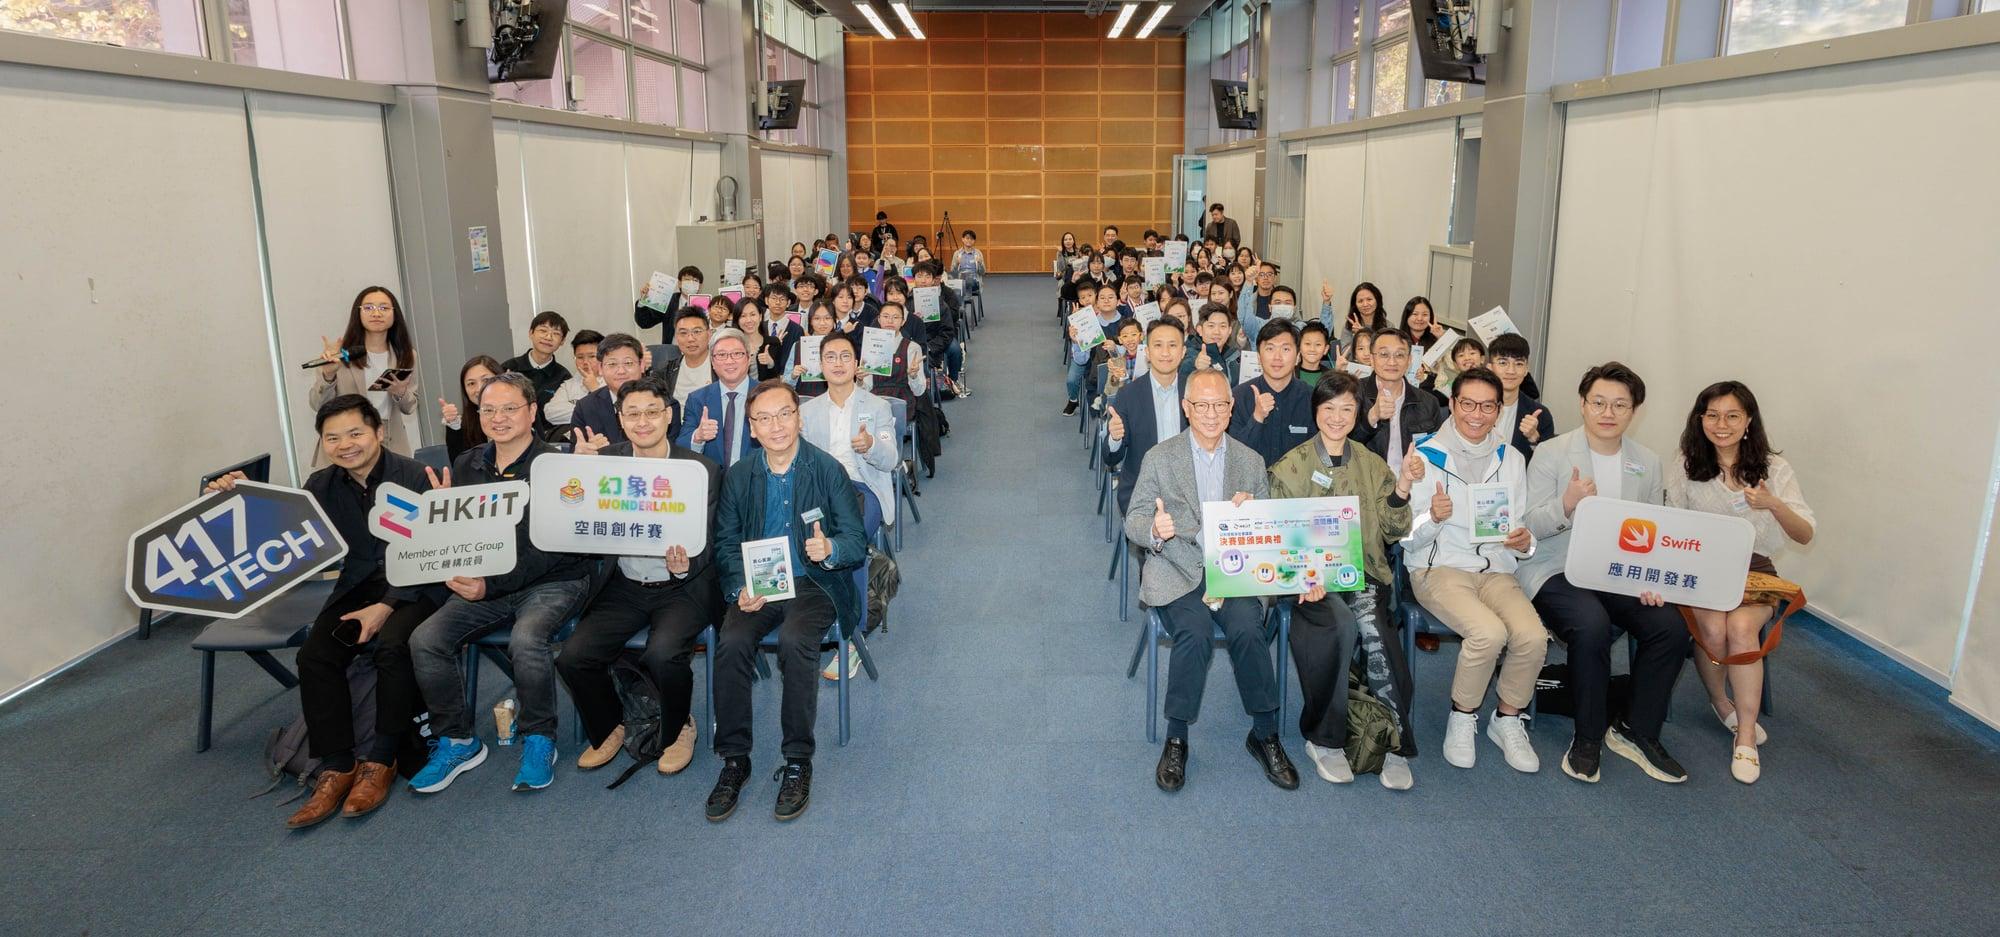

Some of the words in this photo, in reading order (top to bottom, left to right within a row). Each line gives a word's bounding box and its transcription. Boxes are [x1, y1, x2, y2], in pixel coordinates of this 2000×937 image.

[598, 474, 673, 498] 幻象島
[597, 499, 686, 513] WONDERLAND
[574, 520, 662, 539] 空間創作賽
[145, 493, 248, 593] 417
[397, 548, 437, 561] Member
[439, 546, 450, 556] of
[452, 543, 472, 554] VTC
[475, 541, 504, 553] Group
[1660, 535, 1701, 552] Swift
[200, 519, 325, 601] TECH
[419, 561, 439, 572] VTC
[441, 555, 483, 569] 機構成員
[1607, 562, 1698, 590] 應用開發賽
